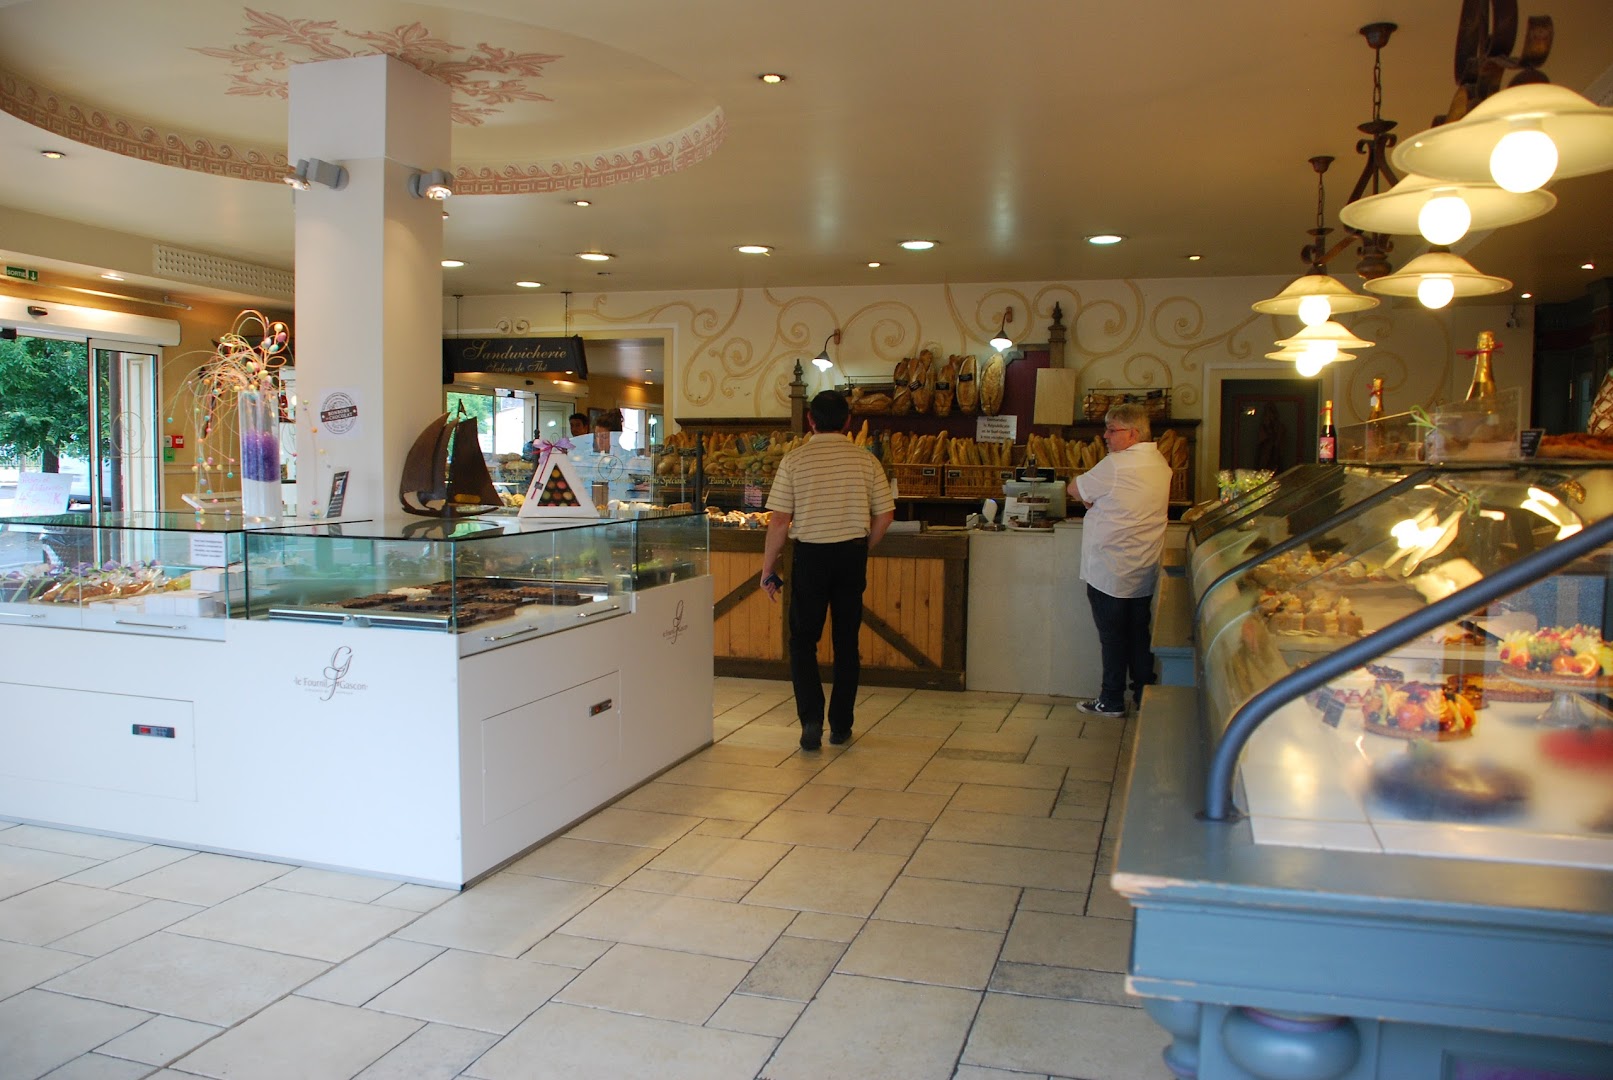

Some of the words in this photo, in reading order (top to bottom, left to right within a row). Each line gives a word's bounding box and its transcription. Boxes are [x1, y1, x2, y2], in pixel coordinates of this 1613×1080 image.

[7, 269, 26, 277] SORTIE
[462, 340, 567, 360] Sandwicherie
[486, 361, 512, 372] Salon
[514, 362, 525, 372] de
[528, 360, 548, 372] Thé
[707, 476, 725, 485] Pains
[303, 677, 328, 687] Fournil
[339, 680, 366, 690] Gascon
